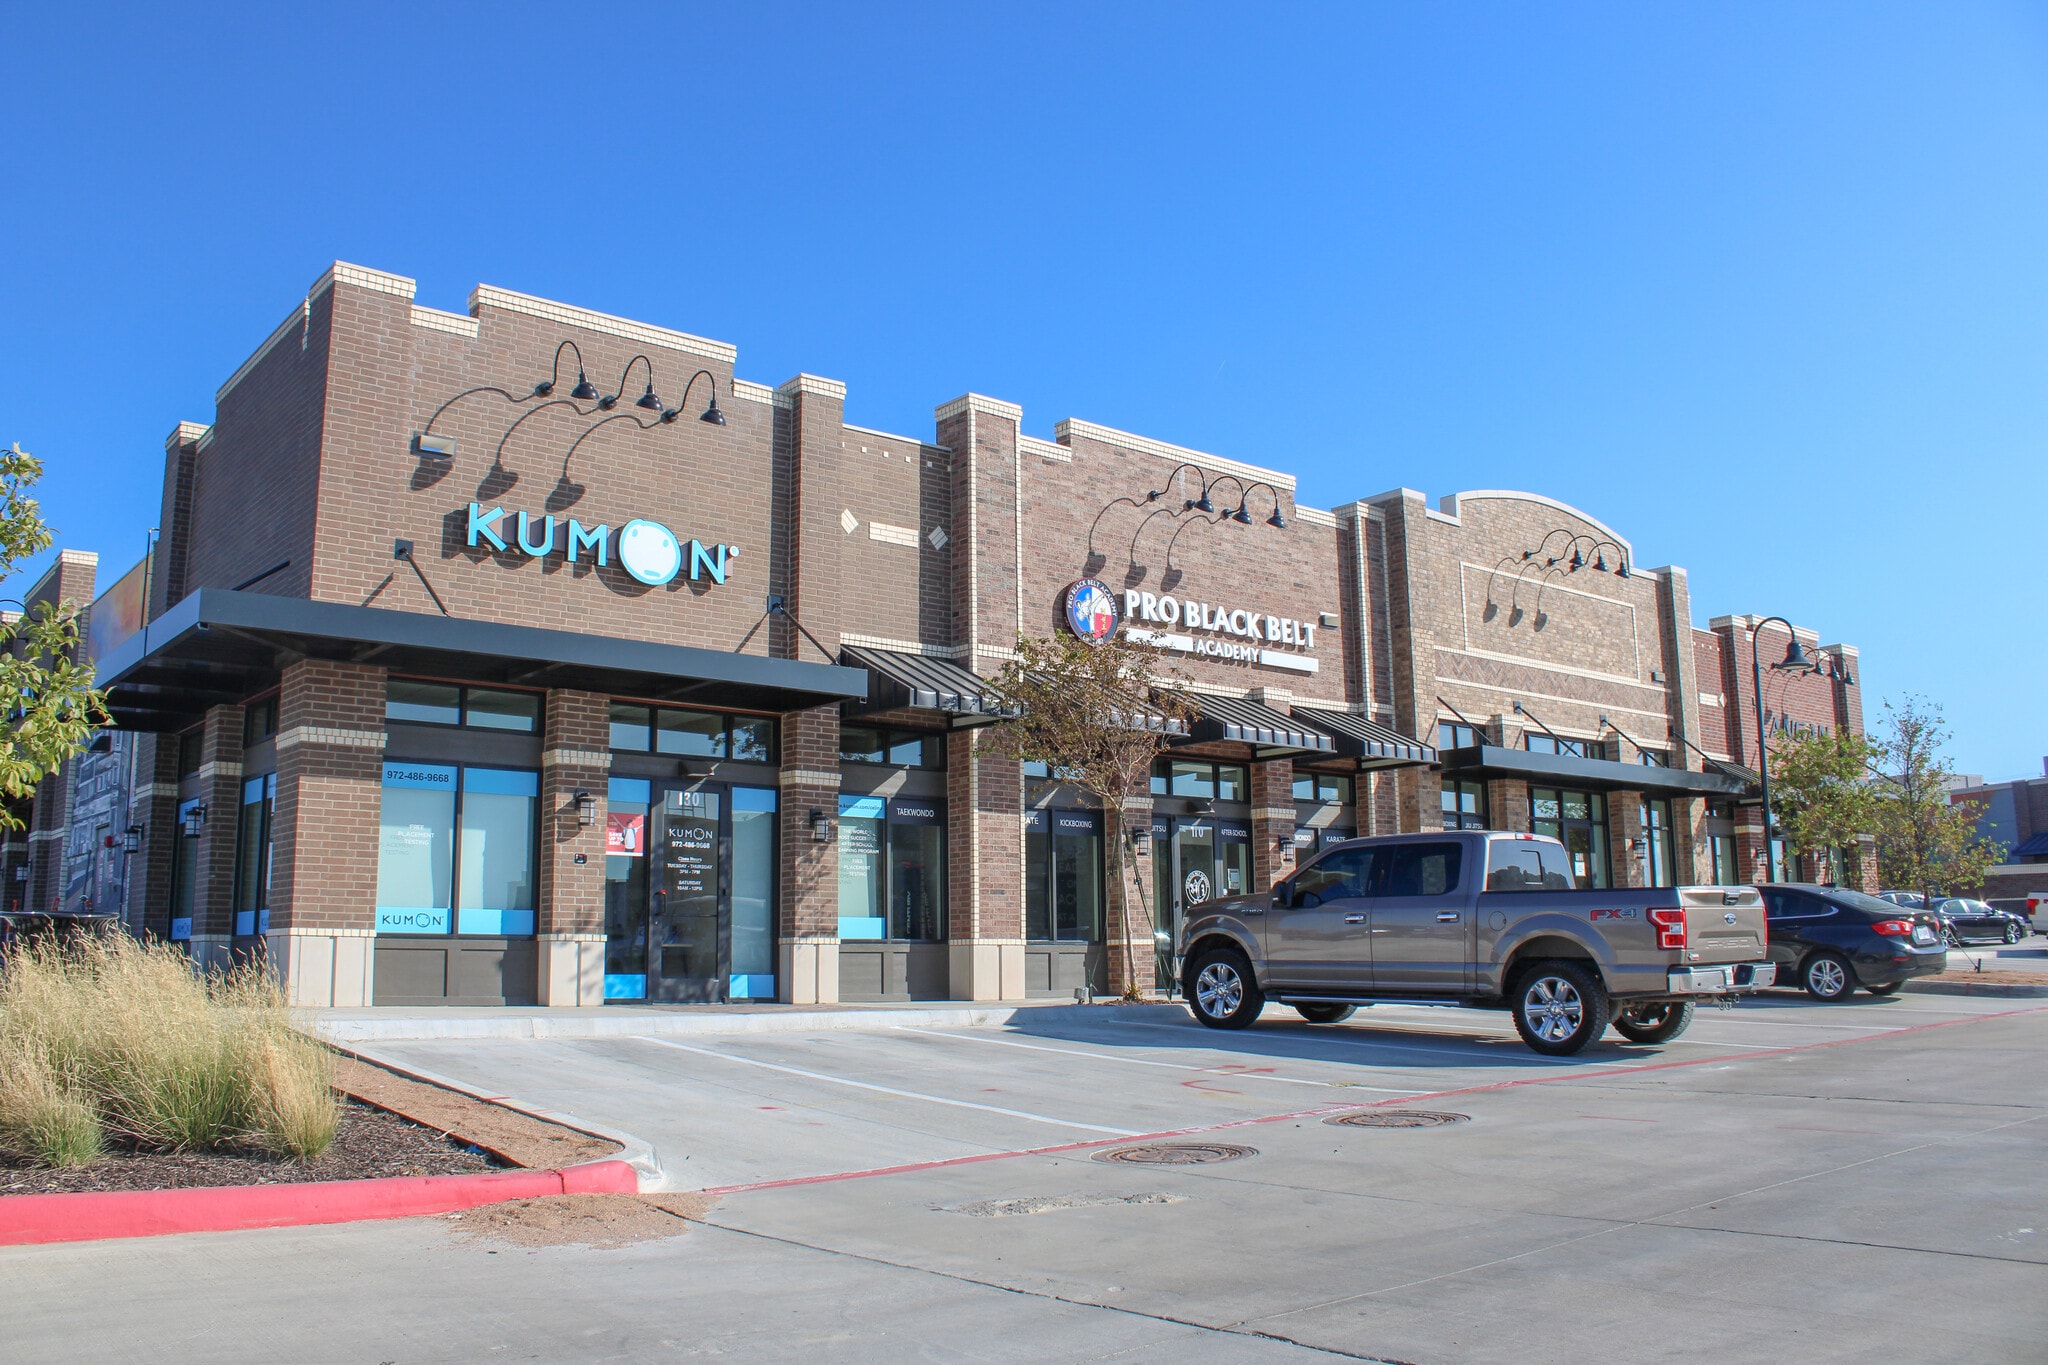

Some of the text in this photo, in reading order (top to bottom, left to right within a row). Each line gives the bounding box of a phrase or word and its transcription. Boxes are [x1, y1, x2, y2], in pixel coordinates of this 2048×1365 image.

[1087, 579, 1100, 588] BELT
[1124, 589, 1317, 648] PRO BLACK BELT
[1195, 638, 1260, 663] ACADEMY
[387, 770, 449, 783] 972-486-9668
[678, 792, 700, 806] 130
[896, 808, 935, 817] TAEKWONDO
[1025, 816, 1039, 825] ATE
[1059, 819, 1093, 828] KICKBOXING
[396, 831, 435, 839] PLACEMENT
[668, 827, 713, 840] KUMON
[1191, 826, 1204, 837] 110
[404, 839, 430, 847] TESTING
[382, 912, 442, 928] KUMON
[1590, 908, 1637, 921] FX4
